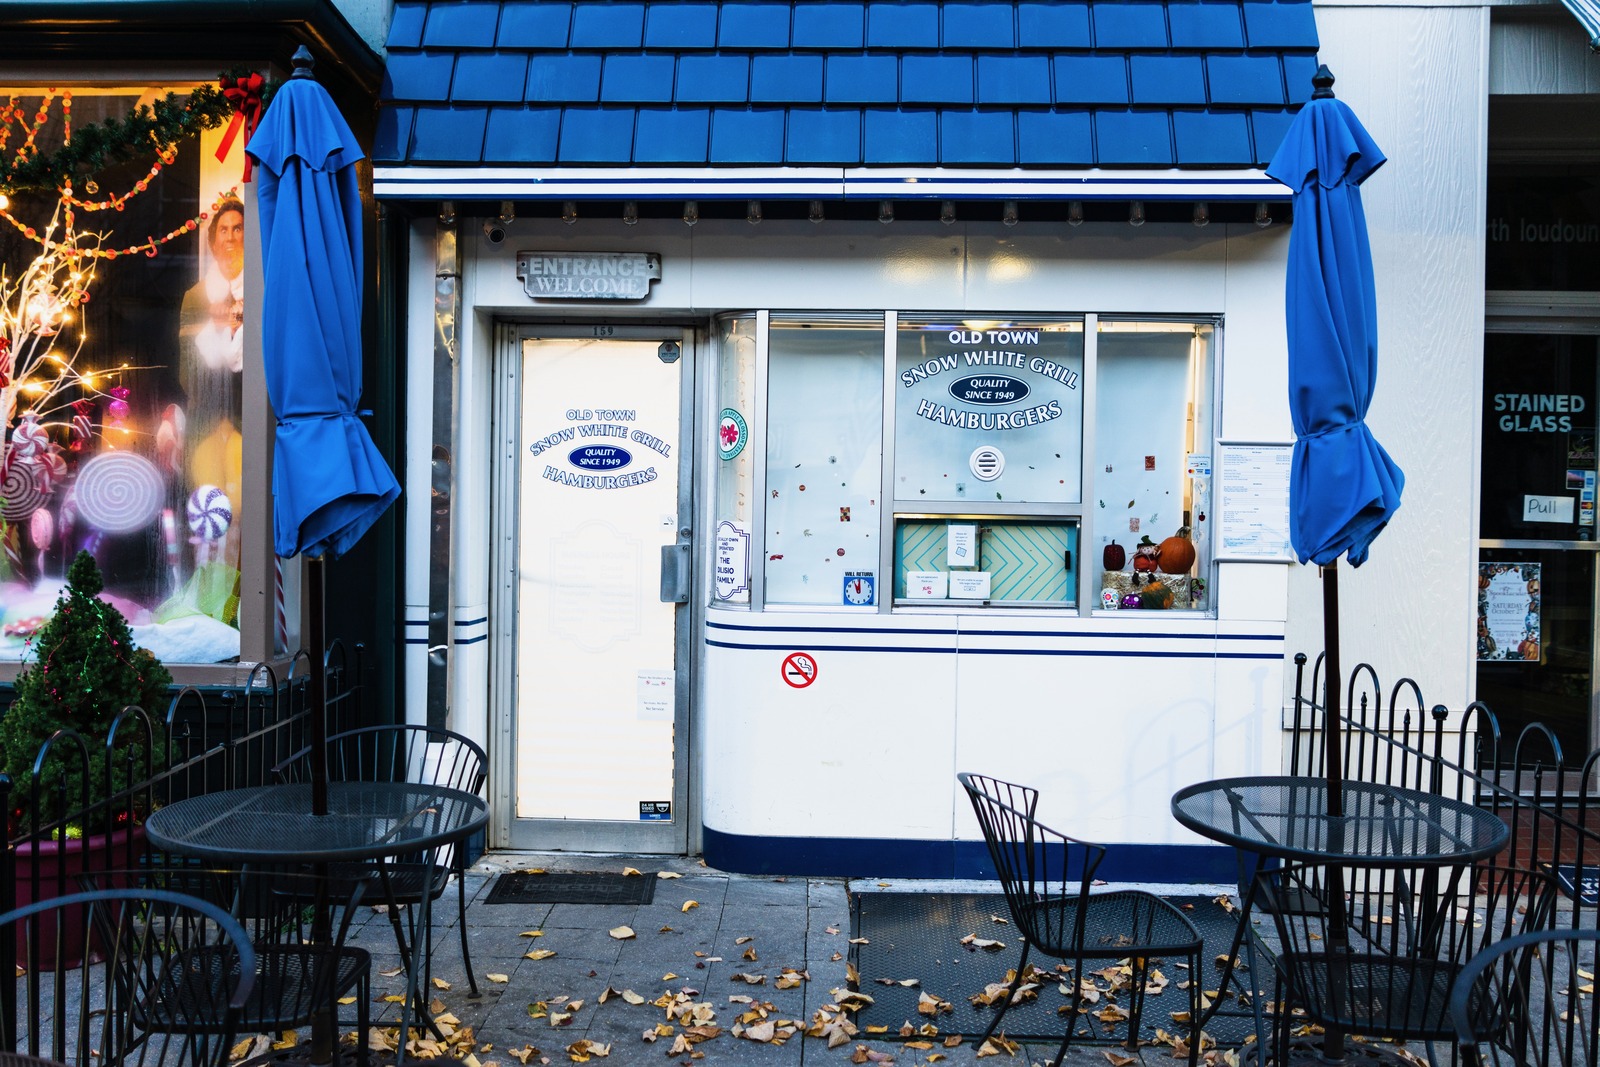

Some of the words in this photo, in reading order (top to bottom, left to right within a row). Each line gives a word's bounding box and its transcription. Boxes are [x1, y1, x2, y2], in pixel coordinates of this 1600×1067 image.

[1520, 217, 1598, 242] loudoun
[529, 257, 647, 277] ENTRANCE
[536, 277, 640, 294] WELCOME
[593, 326, 614, 336] 159
[948, 330, 983, 345] OLD
[986, 330, 1039, 345] TOWN
[900, 353, 958, 388] SNOW
[963, 350, 1026, 368] WHITE
[1029, 356, 1079, 390] GRILL
[970, 379, 1011, 389] QUALITY
[965, 391, 992, 400] SINCE
[994, 391, 1015, 400] 1949
[1494, 393, 1585, 413] STAINED
[566, 409, 593, 421] OLD
[594, 409, 636, 421] TOWN
[917, 399, 1063, 430] HAMBURGERS
[1499, 414, 1572, 433] GLASS
[529, 426, 576, 457] SNOW
[577, 424, 629, 439] WHITE
[630, 429, 672, 459] GRILL
[585, 448, 617, 457] QUALITY
[579, 458, 600, 466] SINCE
[602, 458, 621, 466] 1949
[542, 465, 658, 490] HAMBURGERS
[1528, 498, 1557, 514] Pull
[719, 557, 731, 565] THE
[717, 576, 735, 584] FAMILY
